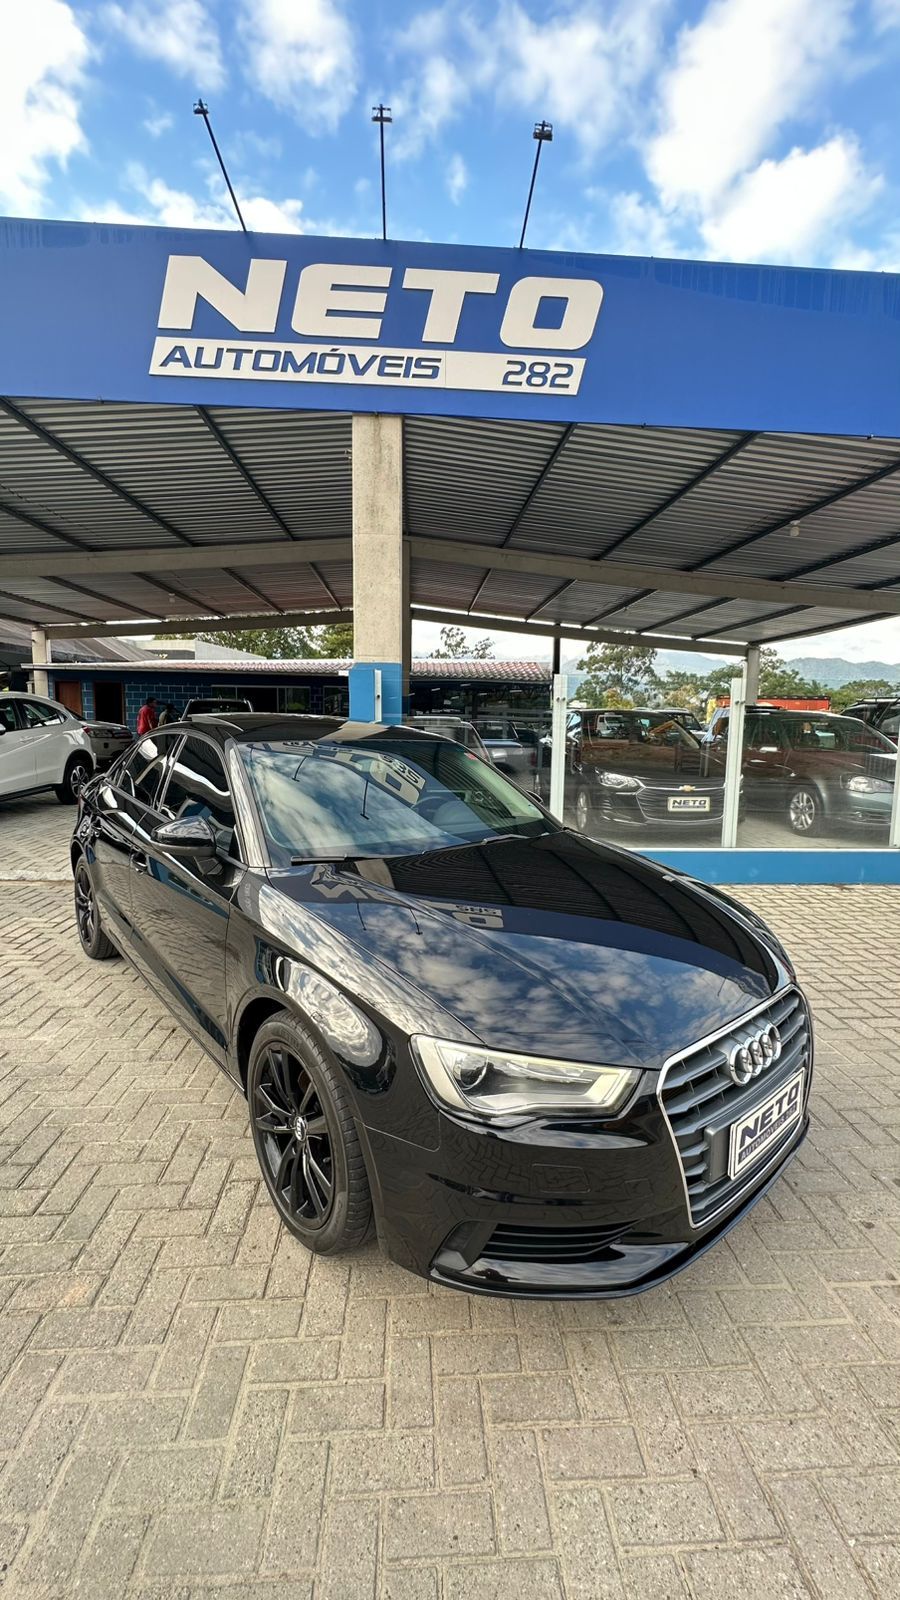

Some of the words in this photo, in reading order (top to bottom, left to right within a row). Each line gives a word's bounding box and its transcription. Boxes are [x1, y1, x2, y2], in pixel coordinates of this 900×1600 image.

[157, 254, 604, 350] NETO
[160, 345, 443, 380] AUTOMÓVEIS
[501, 360, 574, 389] 282
[739, 1081, 799, 1149] NETO
